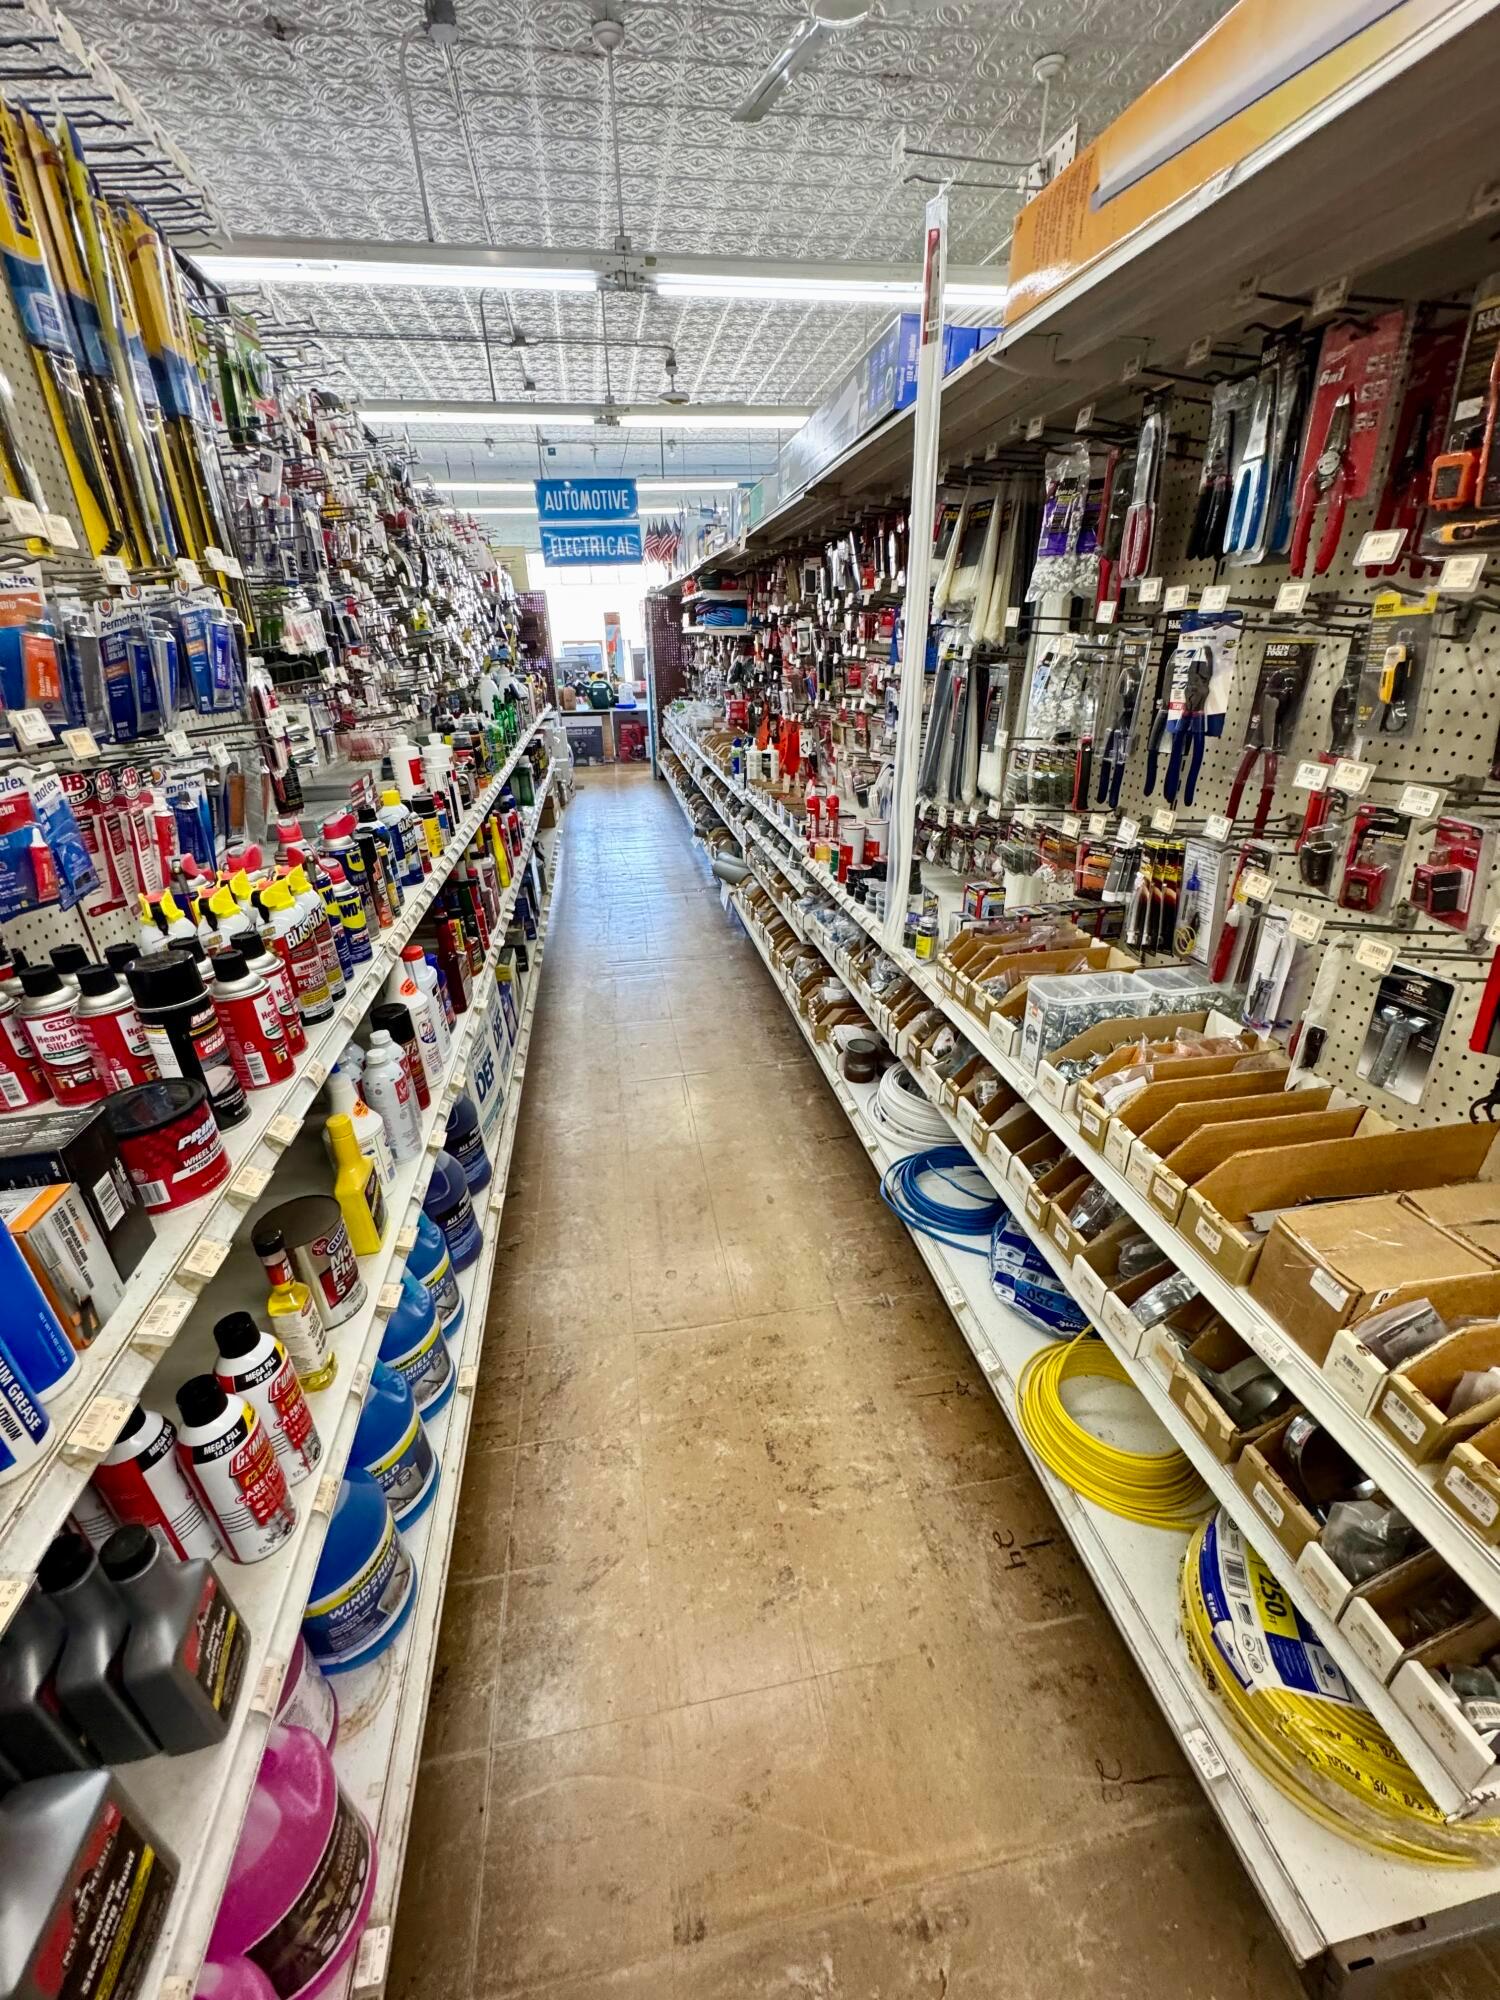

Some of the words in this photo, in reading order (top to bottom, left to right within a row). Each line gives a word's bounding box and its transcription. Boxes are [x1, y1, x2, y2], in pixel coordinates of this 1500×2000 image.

[544, 489, 630, 511] AUTOMOTIVE
[550, 536, 634, 557] ELECTRICAL
[101, 612, 139, 631] Permatex
[69, 791, 89, 804] ELD
[341, 901, 362, 918] WD-
[297, 975, 324, 988] PENET
[44, 1016, 74, 1032] CRC
[36, 1030, 68, 1047] Heavy
[46, 1037, 85, 1053] Silicon
[475, 1050, 494, 1104] DEF
[58, 1206, 71, 1226] LEVER
[67, 1225, 82, 1250] GREASE
[447, 1216, 458, 1226] ALL
[328, 1223, 345, 1252] GUN
[245, 1367, 265, 1383] MEGA
[264, 1356, 277, 1370] FILL
[255, 1376, 264, 1384] 14
[8, 1378, 42, 1432] GREASE
[148, 1435, 166, 1457] MEGA
[204, 1439, 226, 1456] MEGA
[226, 1428, 241, 1444] FILL
[213, 1448, 224, 1458] 14
[1258, 1570, 1288, 1618] 250
[1268, 1613, 1278, 1626] FT
[80, 1903, 119, 1995] Steering
[115, 1849, 136, 1900] Fluid
[88, 1879, 117, 1947] Power
